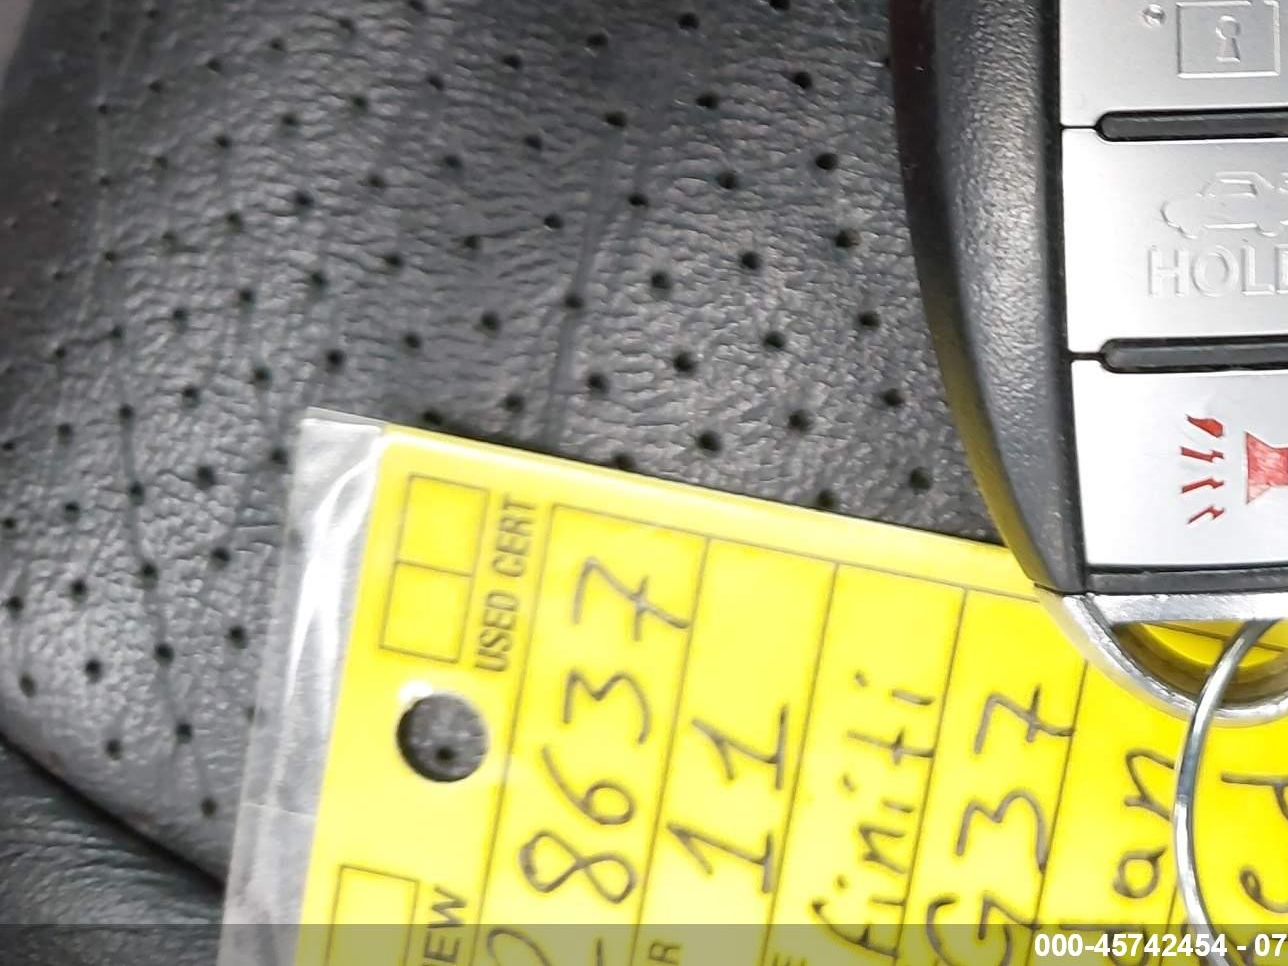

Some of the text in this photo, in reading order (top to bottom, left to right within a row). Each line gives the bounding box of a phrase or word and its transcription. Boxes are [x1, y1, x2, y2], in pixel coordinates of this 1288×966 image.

[474, 492, 536, 673] USED CERT
[926, 683, 1076, 966] G37
[421, 885, 467, 966] EW
